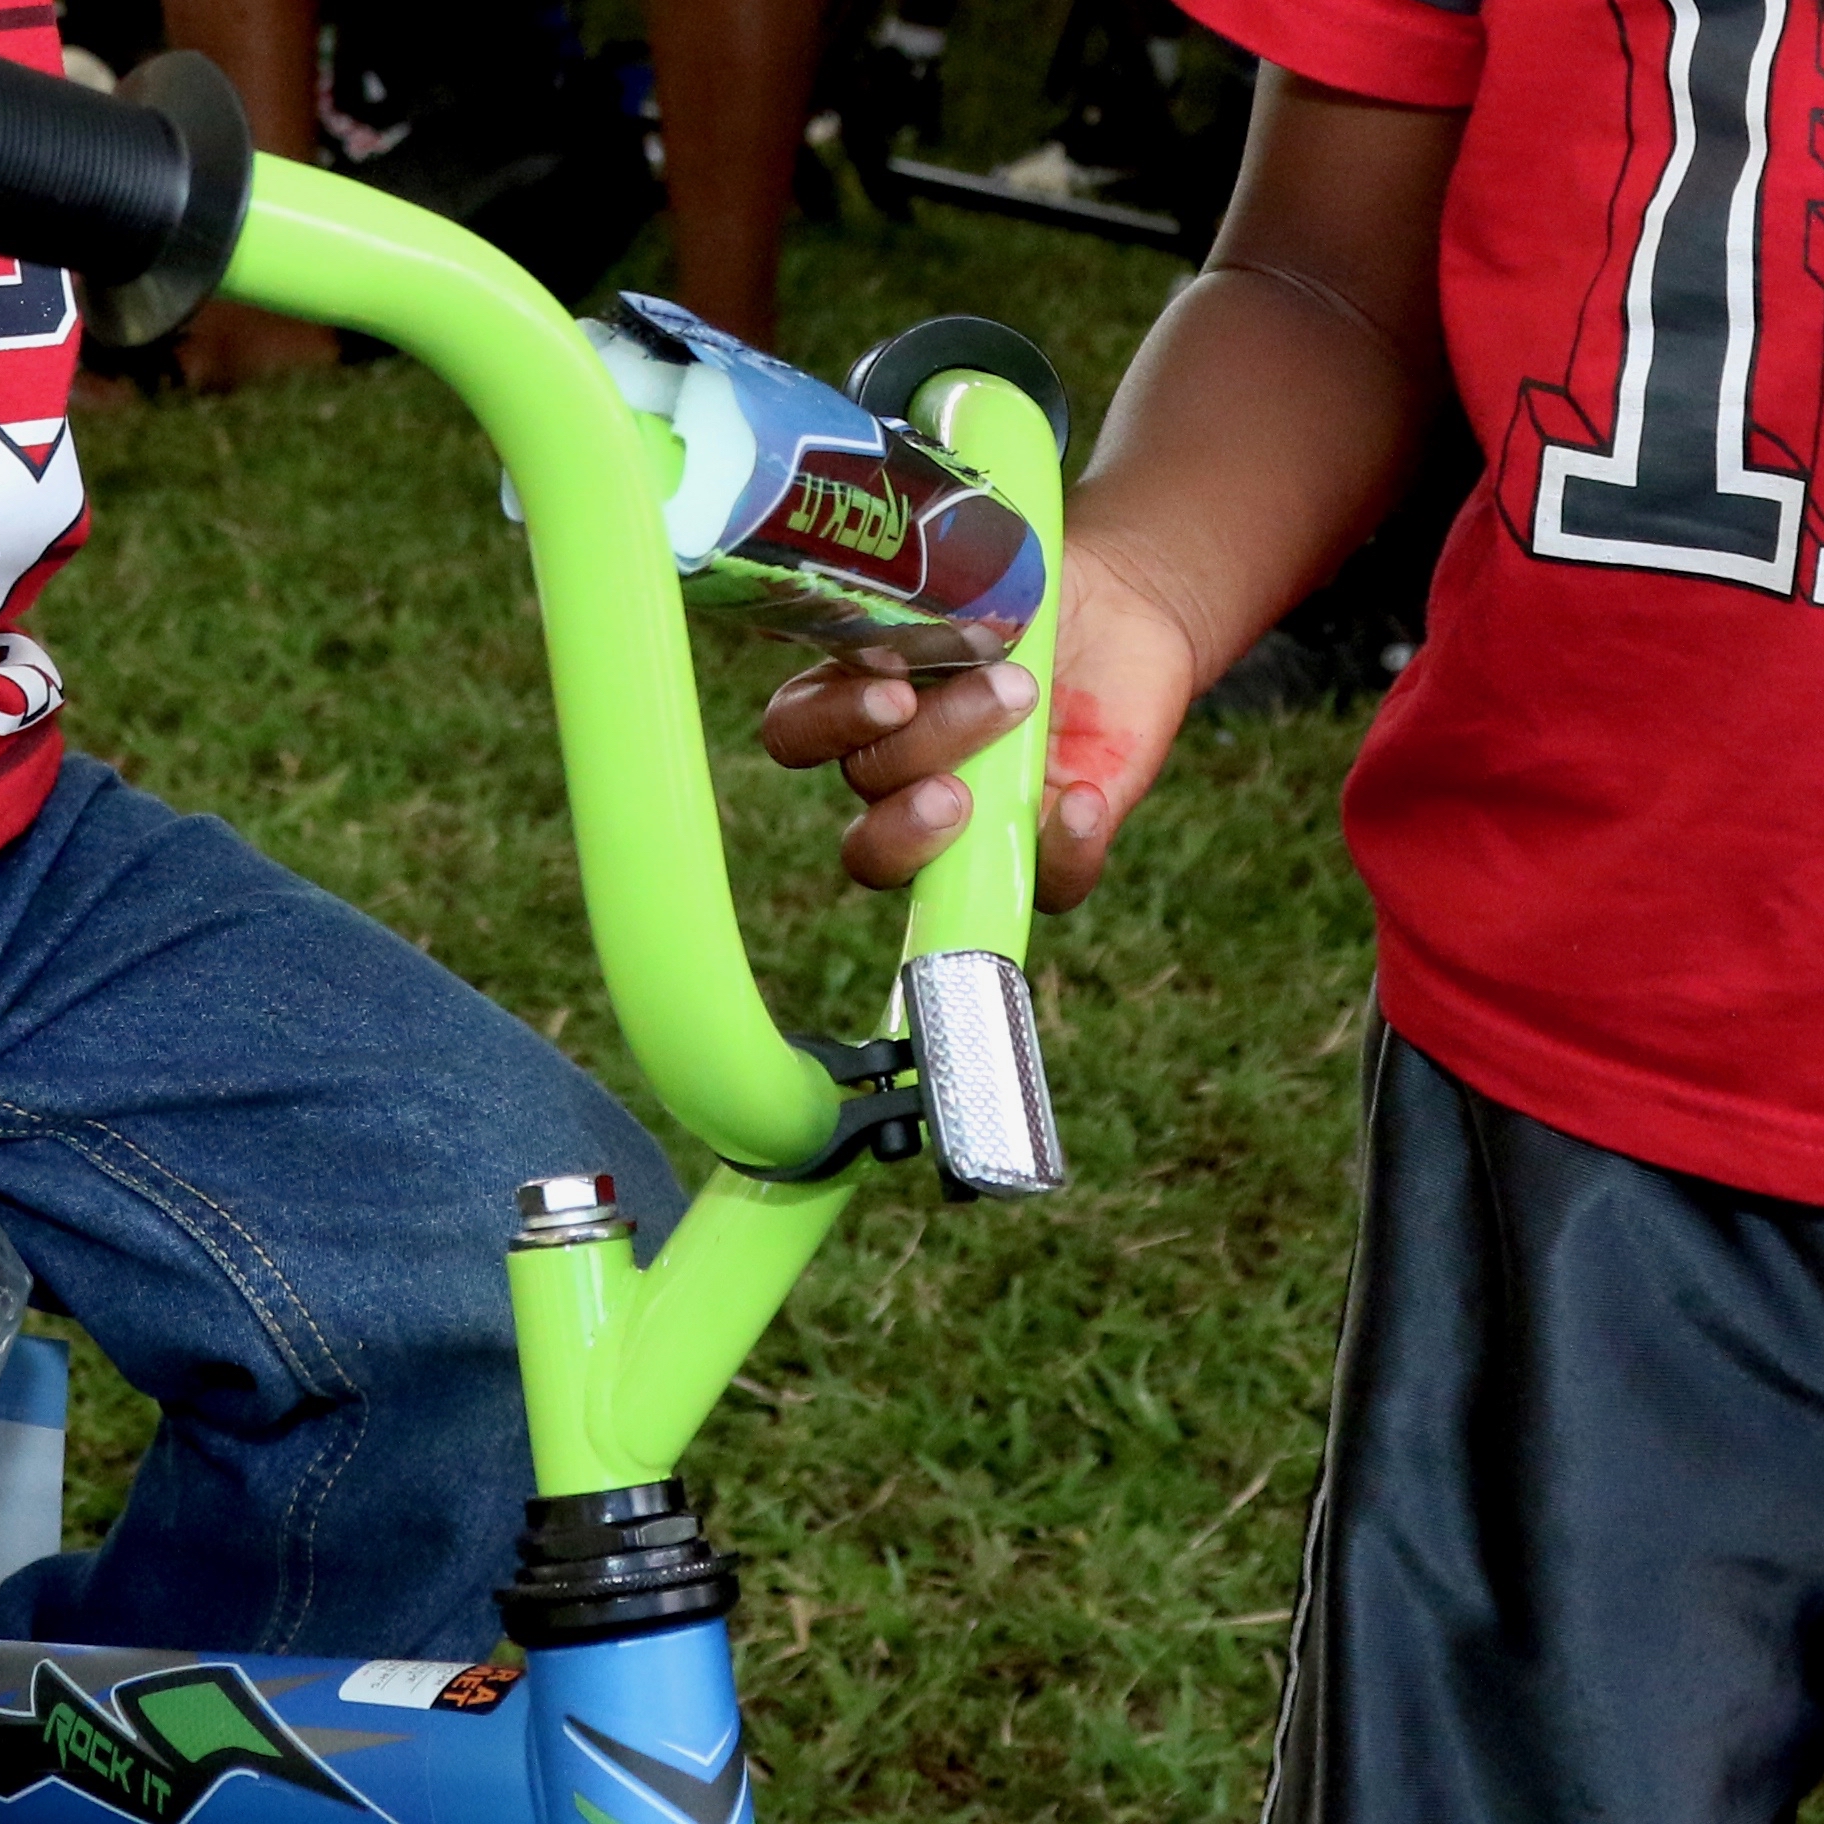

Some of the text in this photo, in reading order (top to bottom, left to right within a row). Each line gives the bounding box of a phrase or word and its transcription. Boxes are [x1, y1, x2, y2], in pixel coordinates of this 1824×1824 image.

[787, 469, 910, 562] ROCK IT
[43, 1702, 172, 1815] ROCK IT
